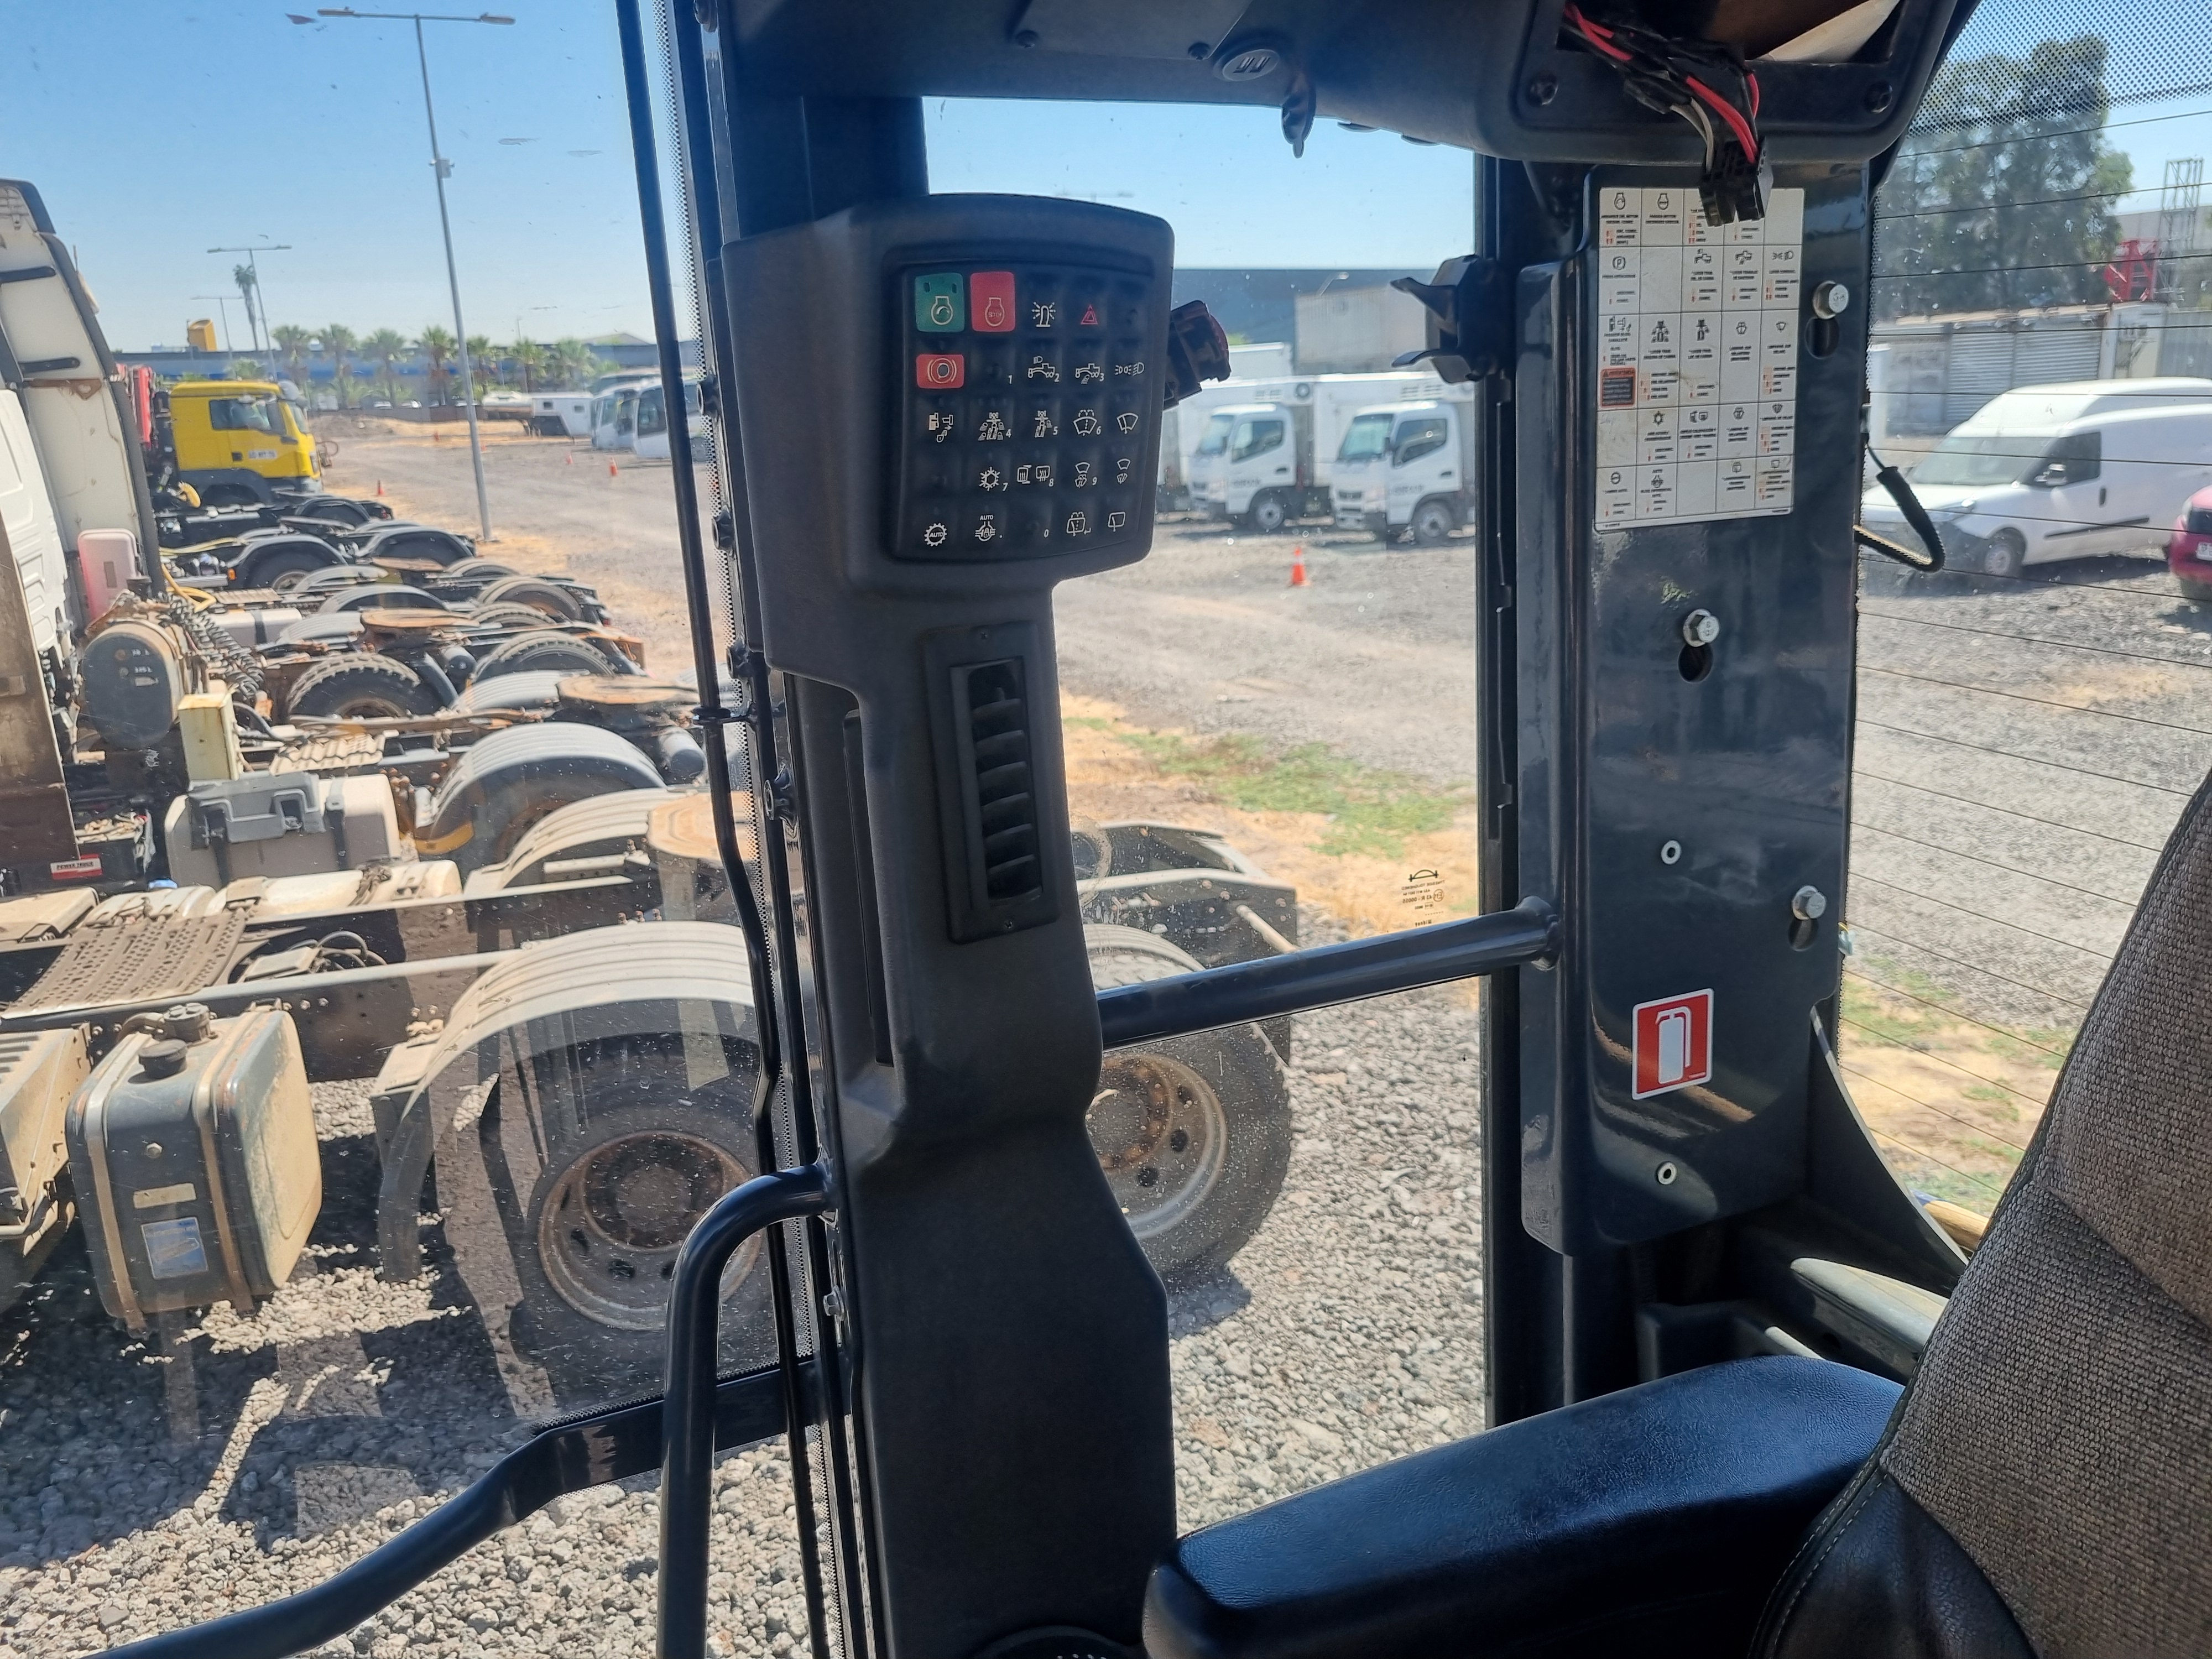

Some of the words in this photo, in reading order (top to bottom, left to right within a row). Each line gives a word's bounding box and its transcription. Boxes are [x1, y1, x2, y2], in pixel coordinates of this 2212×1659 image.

[1008, 375, 1013, 384] 1
[1054, 373, 1060, 382] 2
[1100, 373, 1104, 382] 3
[1005, 429, 1011, 438] 4
[1053, 426, 1058, 435] 5
[1096, 426, 1101, 435] 6
[1048, 478, 1054, 487] 8
[1092, 477, 1097, 485] 9
[1002, 482, 1009, 492] 7
[1044, 529, 1049, 538] 0
